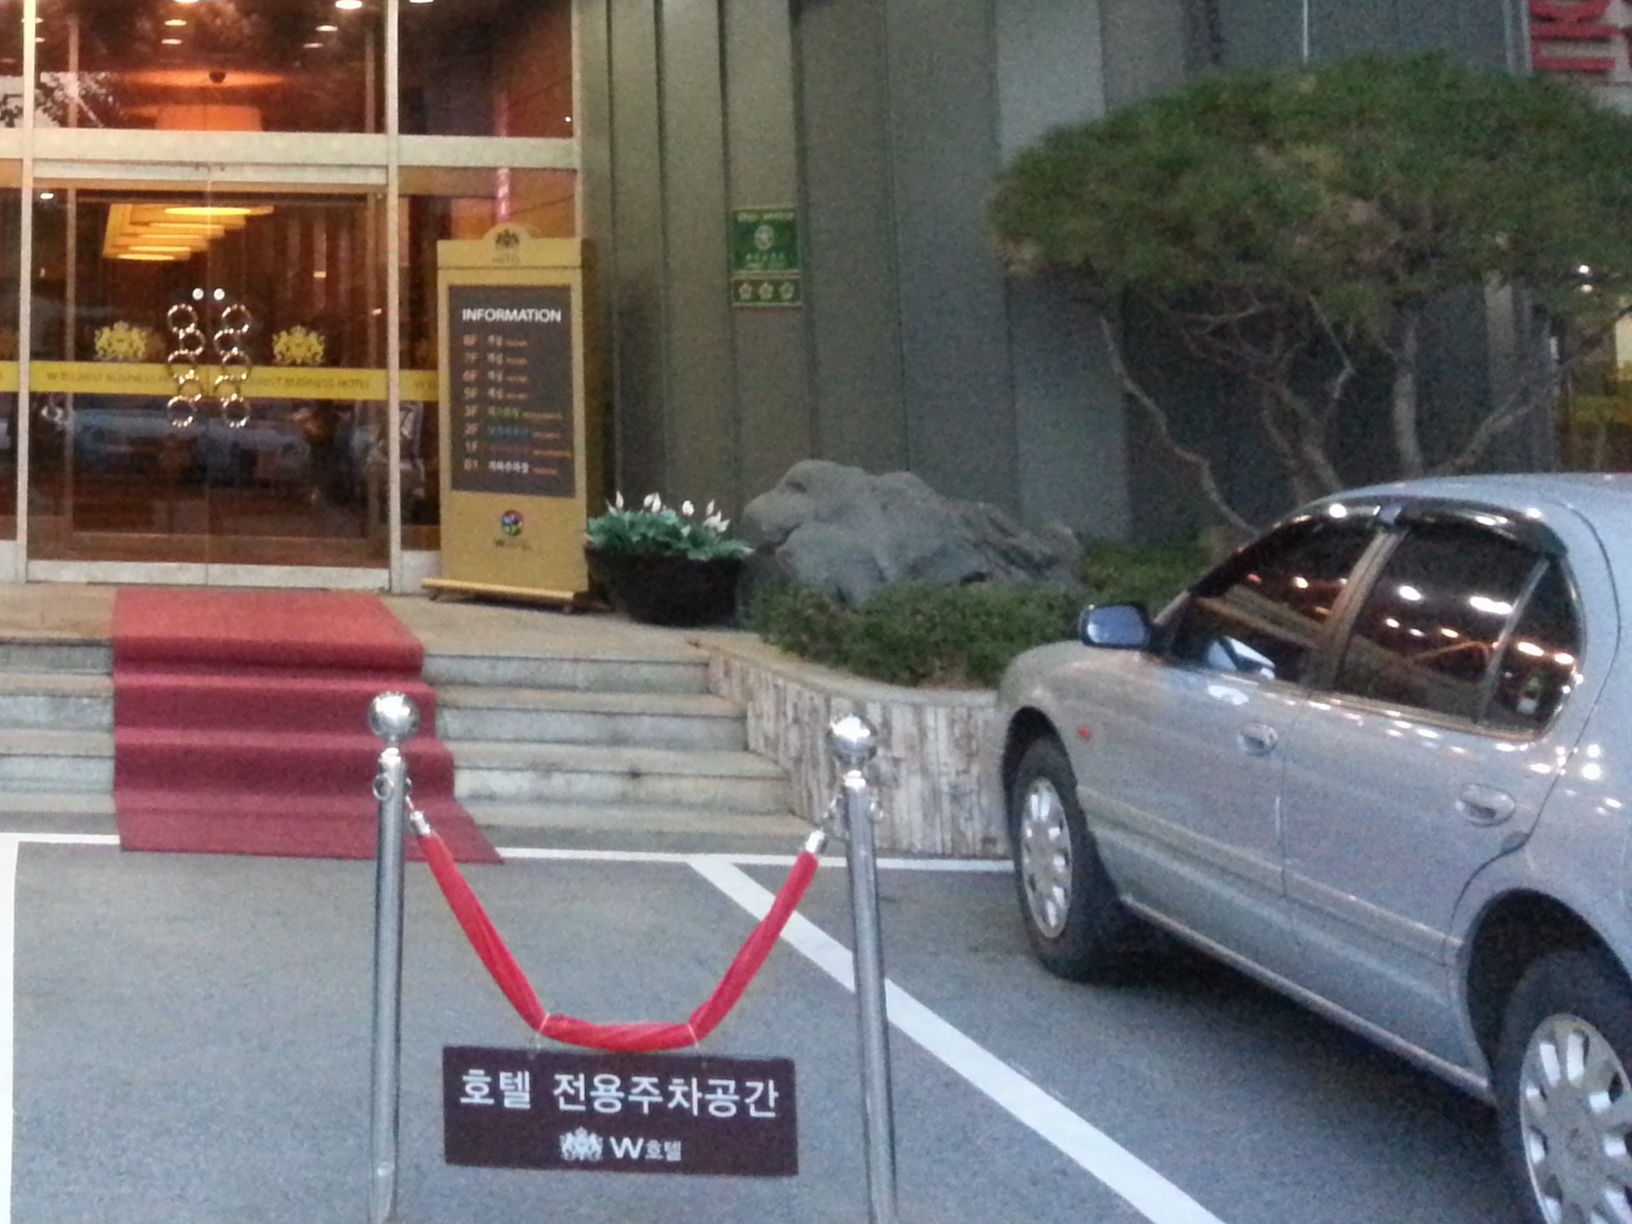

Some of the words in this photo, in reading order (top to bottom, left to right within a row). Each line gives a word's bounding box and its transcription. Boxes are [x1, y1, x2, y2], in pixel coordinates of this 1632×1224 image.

[462, 308, 562, 323] INFORMATION
[460, 1069, 532, 1110] 호텔
[553, 1072, 779, 1117] 전용주차공간
